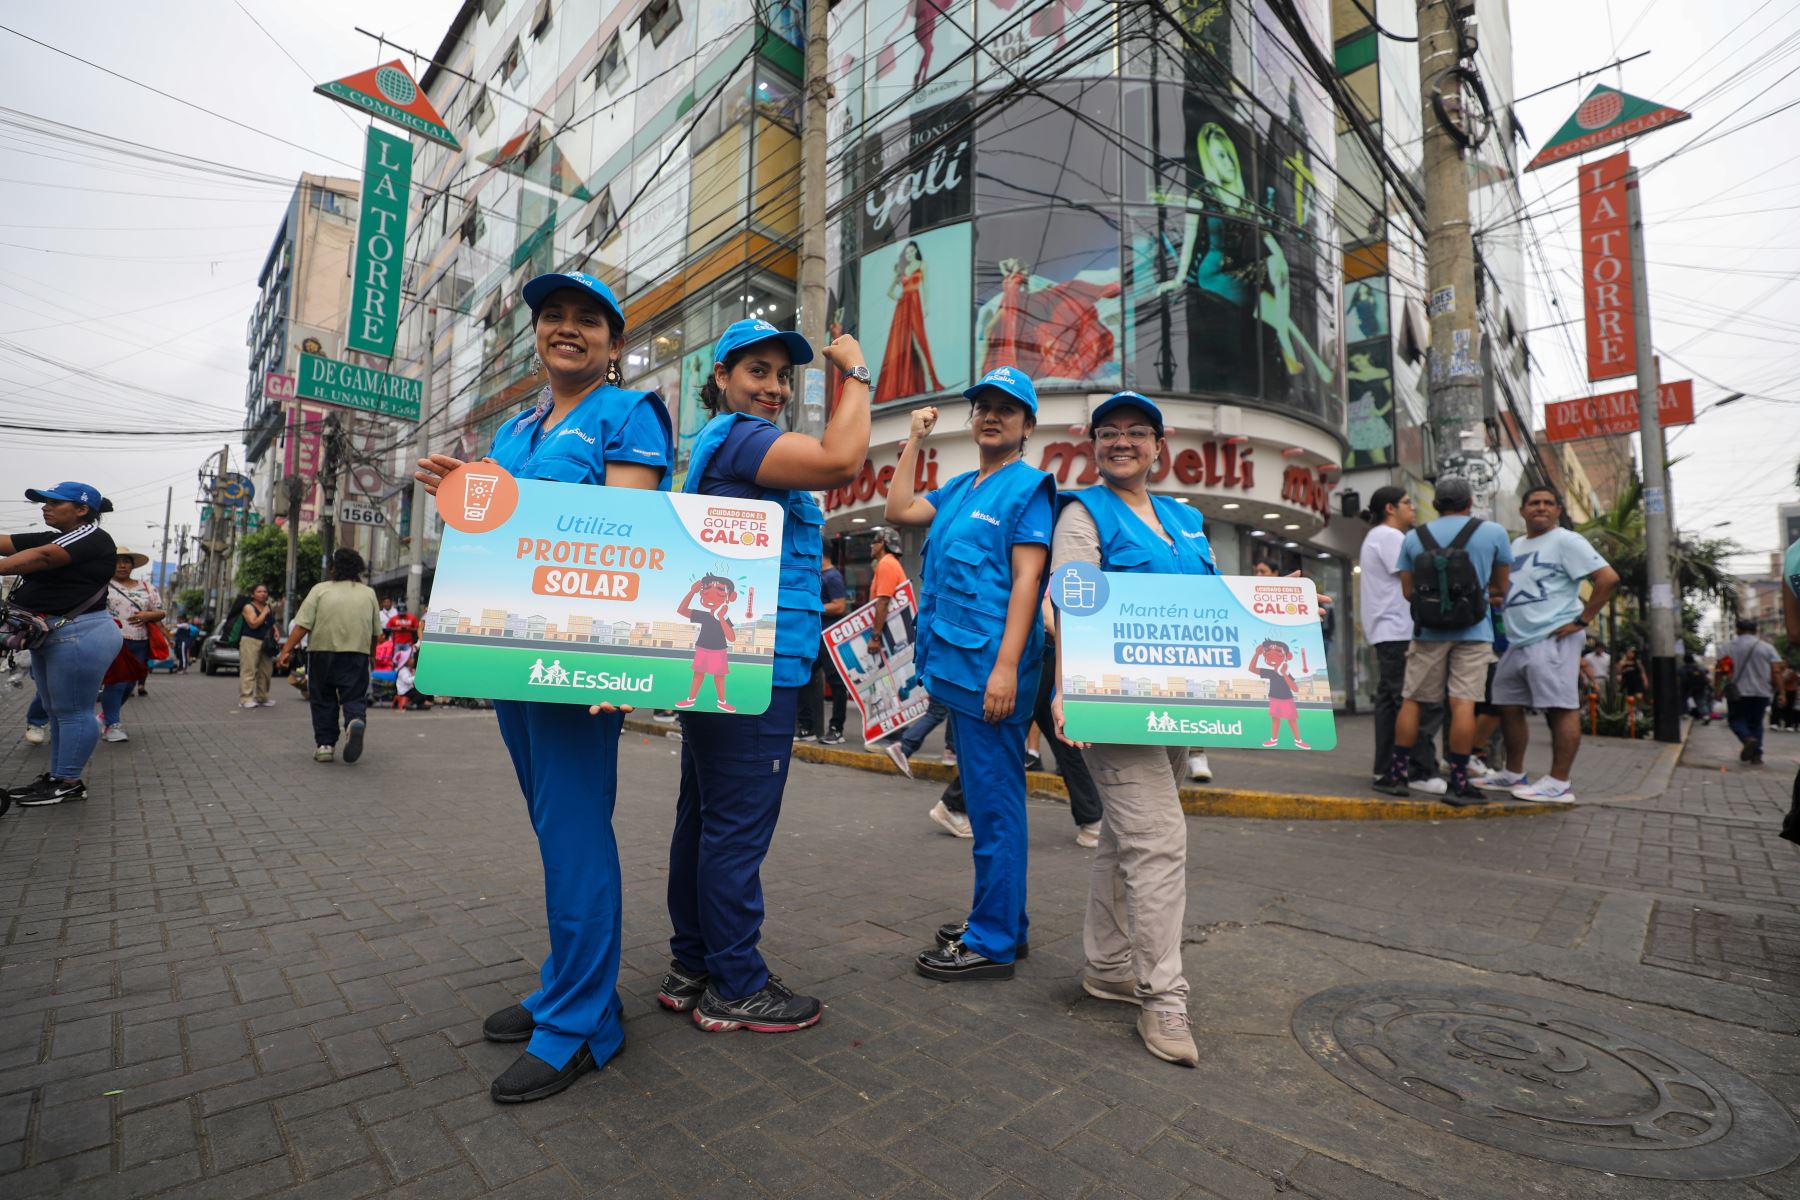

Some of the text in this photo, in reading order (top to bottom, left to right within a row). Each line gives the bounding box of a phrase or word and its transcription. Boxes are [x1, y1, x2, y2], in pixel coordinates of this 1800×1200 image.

[350, 92, 451, 141] COMERCIAL
[1554, 110, 1676, 156] COMERCIAL
[360, 140, 400, 344] LA TORRE
[1590, 167, 1625, 364] LA TORRE
[312, 359, 420, 403] DE GAMARRA
[1557, 387, 1679, 426] DE GAMARA
[343, 508, 384, 524] 1560
[556, 514, 633, 538] Utiliza
[704, 517, 767, 531] GOLPE DE
[742, 511, 755, 519] CON
[756, 512, 764, 520] EL
[700, 528, 769, 547] CALOR
[516, 537, 665, 570] PROTECTOR
[544, 570, 629, 598] SOLAR
[1253, 593, 1305, 603] GOLPE DE
[1253, 603, 1309, 615] CALOR
[830, 589, 910, 645] CORTIAS
[1120, 602, 1229, 619] Mantén una
[1113, 619, 1240, 642] HIDRATACIÓN
[1122, 645, 1235, 665] CONSTANTE
[572, 670, 654, 692] EsSalud
[1180, 719, 1243, 735] EsSalud
